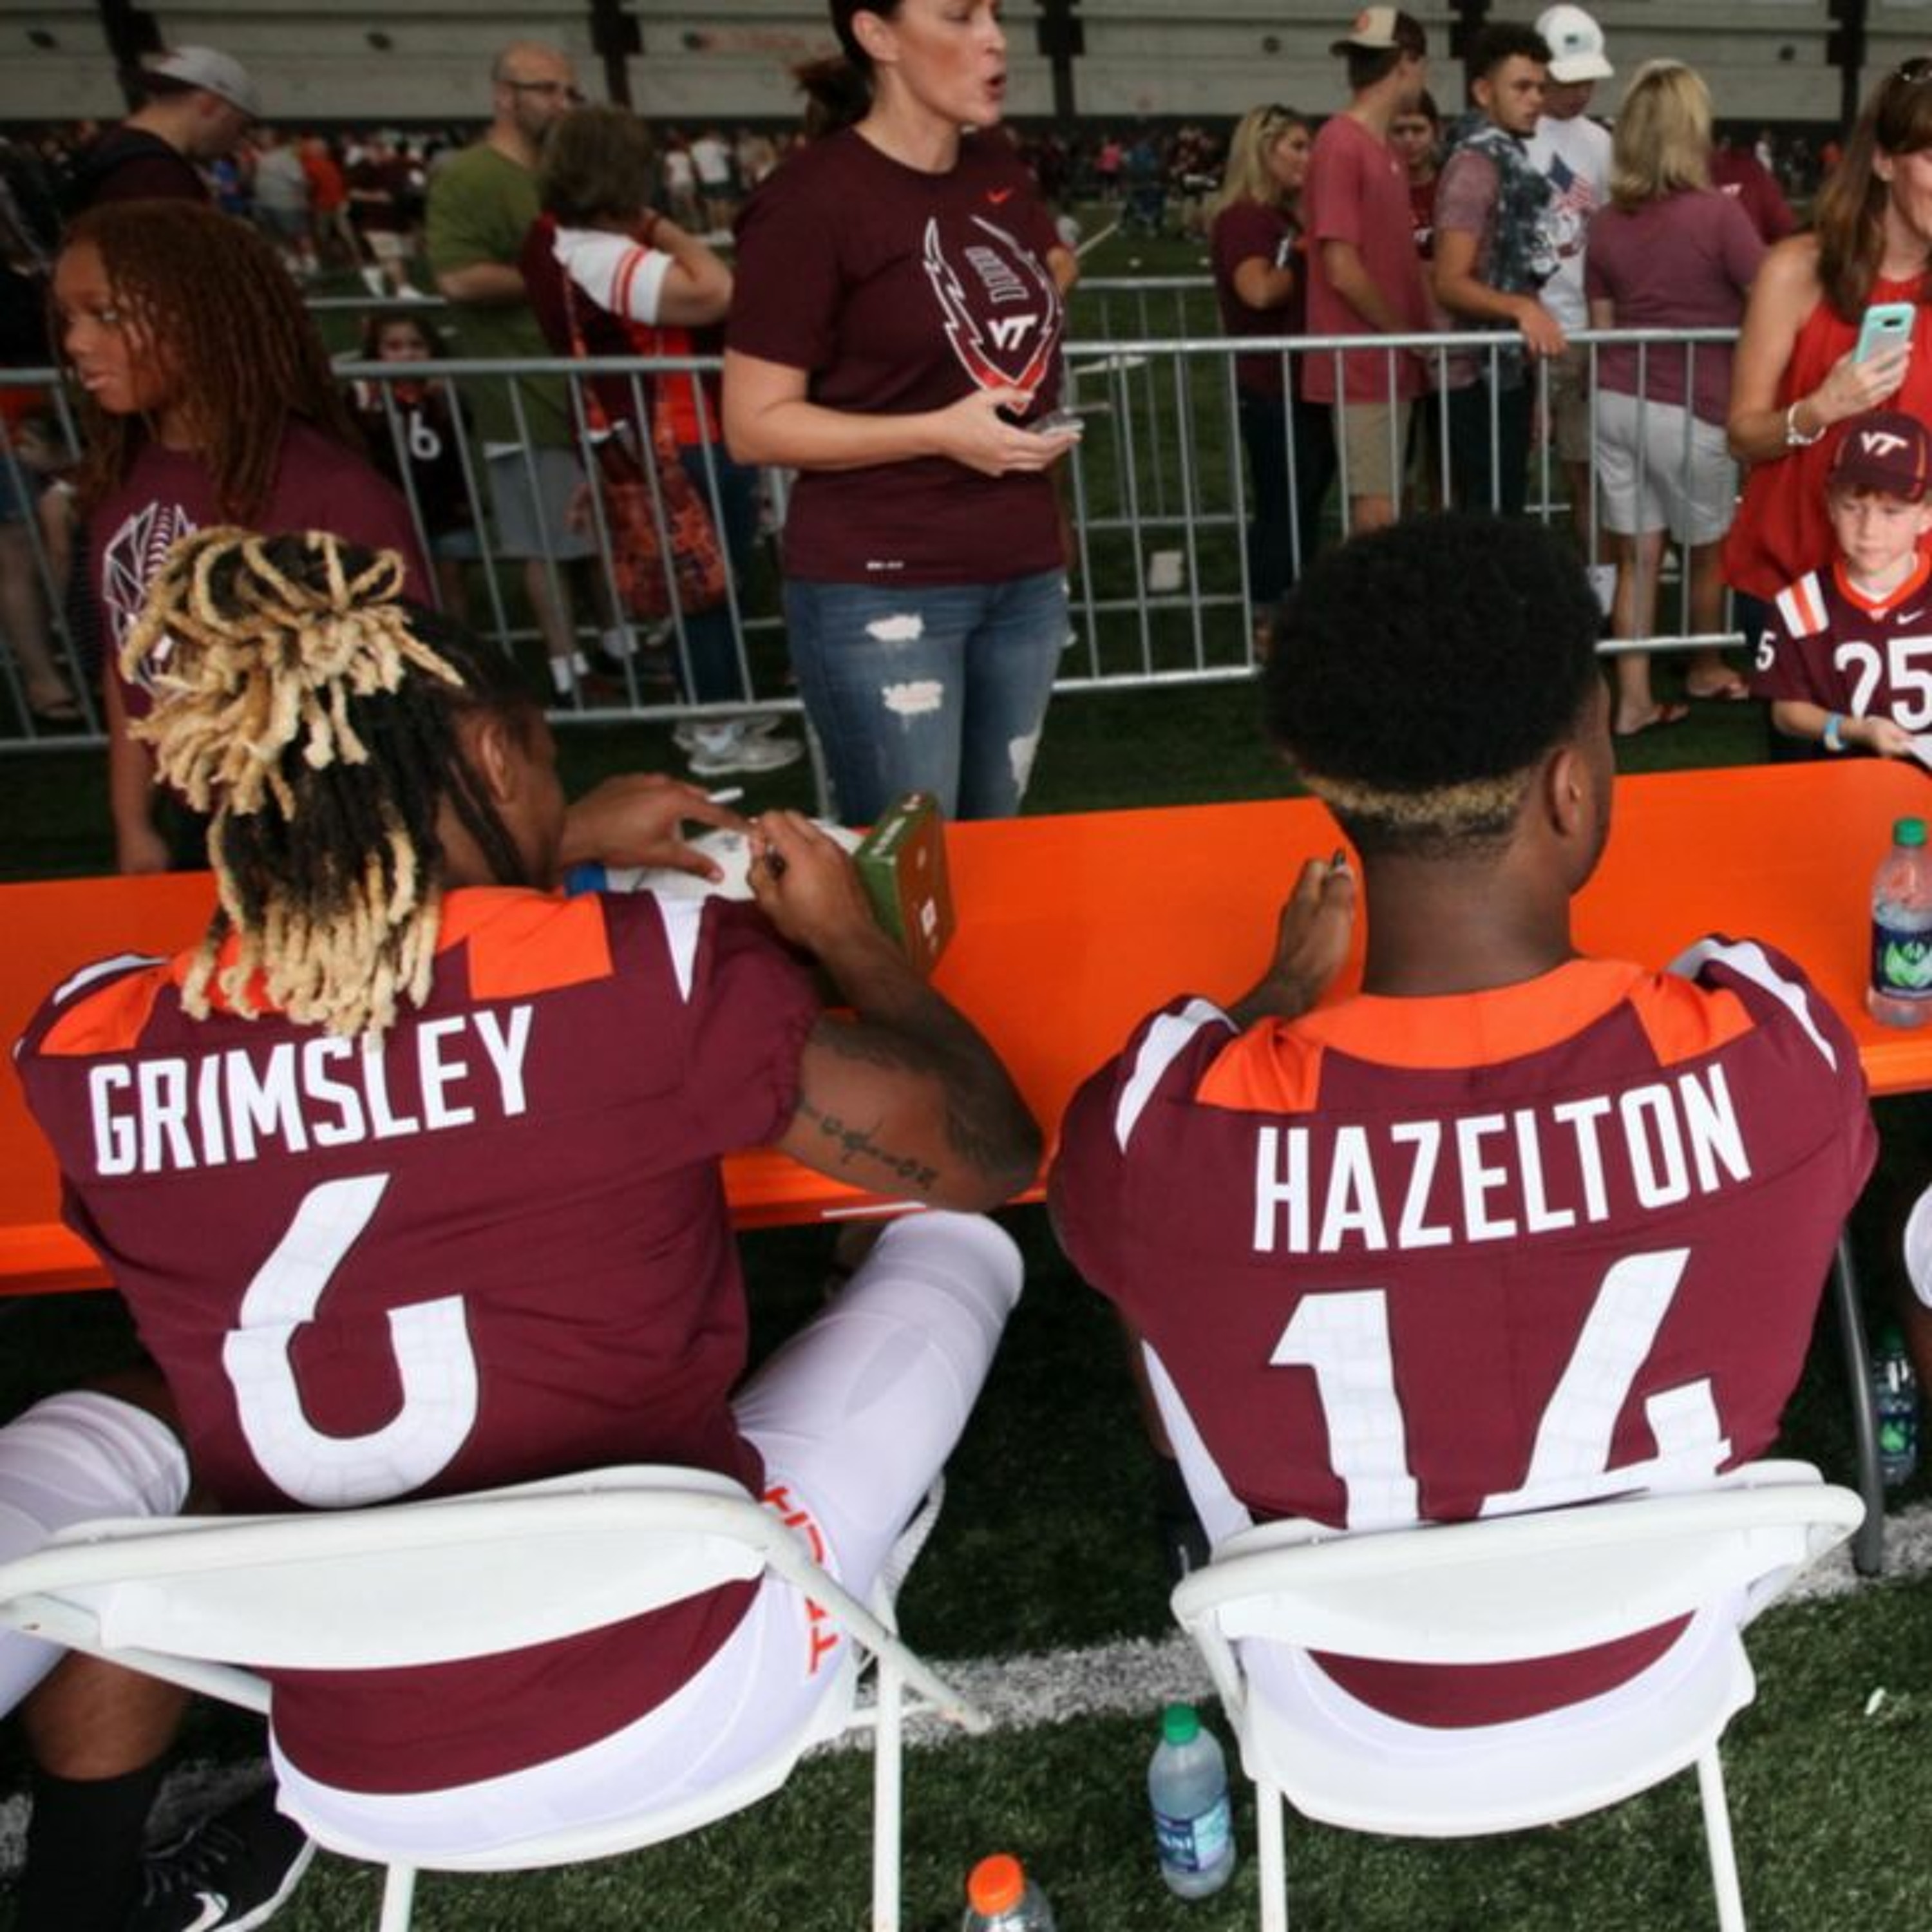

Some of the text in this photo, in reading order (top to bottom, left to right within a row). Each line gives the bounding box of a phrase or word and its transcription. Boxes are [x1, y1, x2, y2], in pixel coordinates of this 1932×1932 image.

[987, 313, 1038, 350] VT
[410, 410, 442, 460] 6
[1859, 431, 1908, 456] VT
[1834, 634, 1932, 730] 25
[88, 1005, 533, 1176] GRIMSLEY
[1253, 1063, 1752, 1253] HAZELTON
[221, 1172, 479, 1508] 6
[1269, 1247, 1732, 1530] 14
